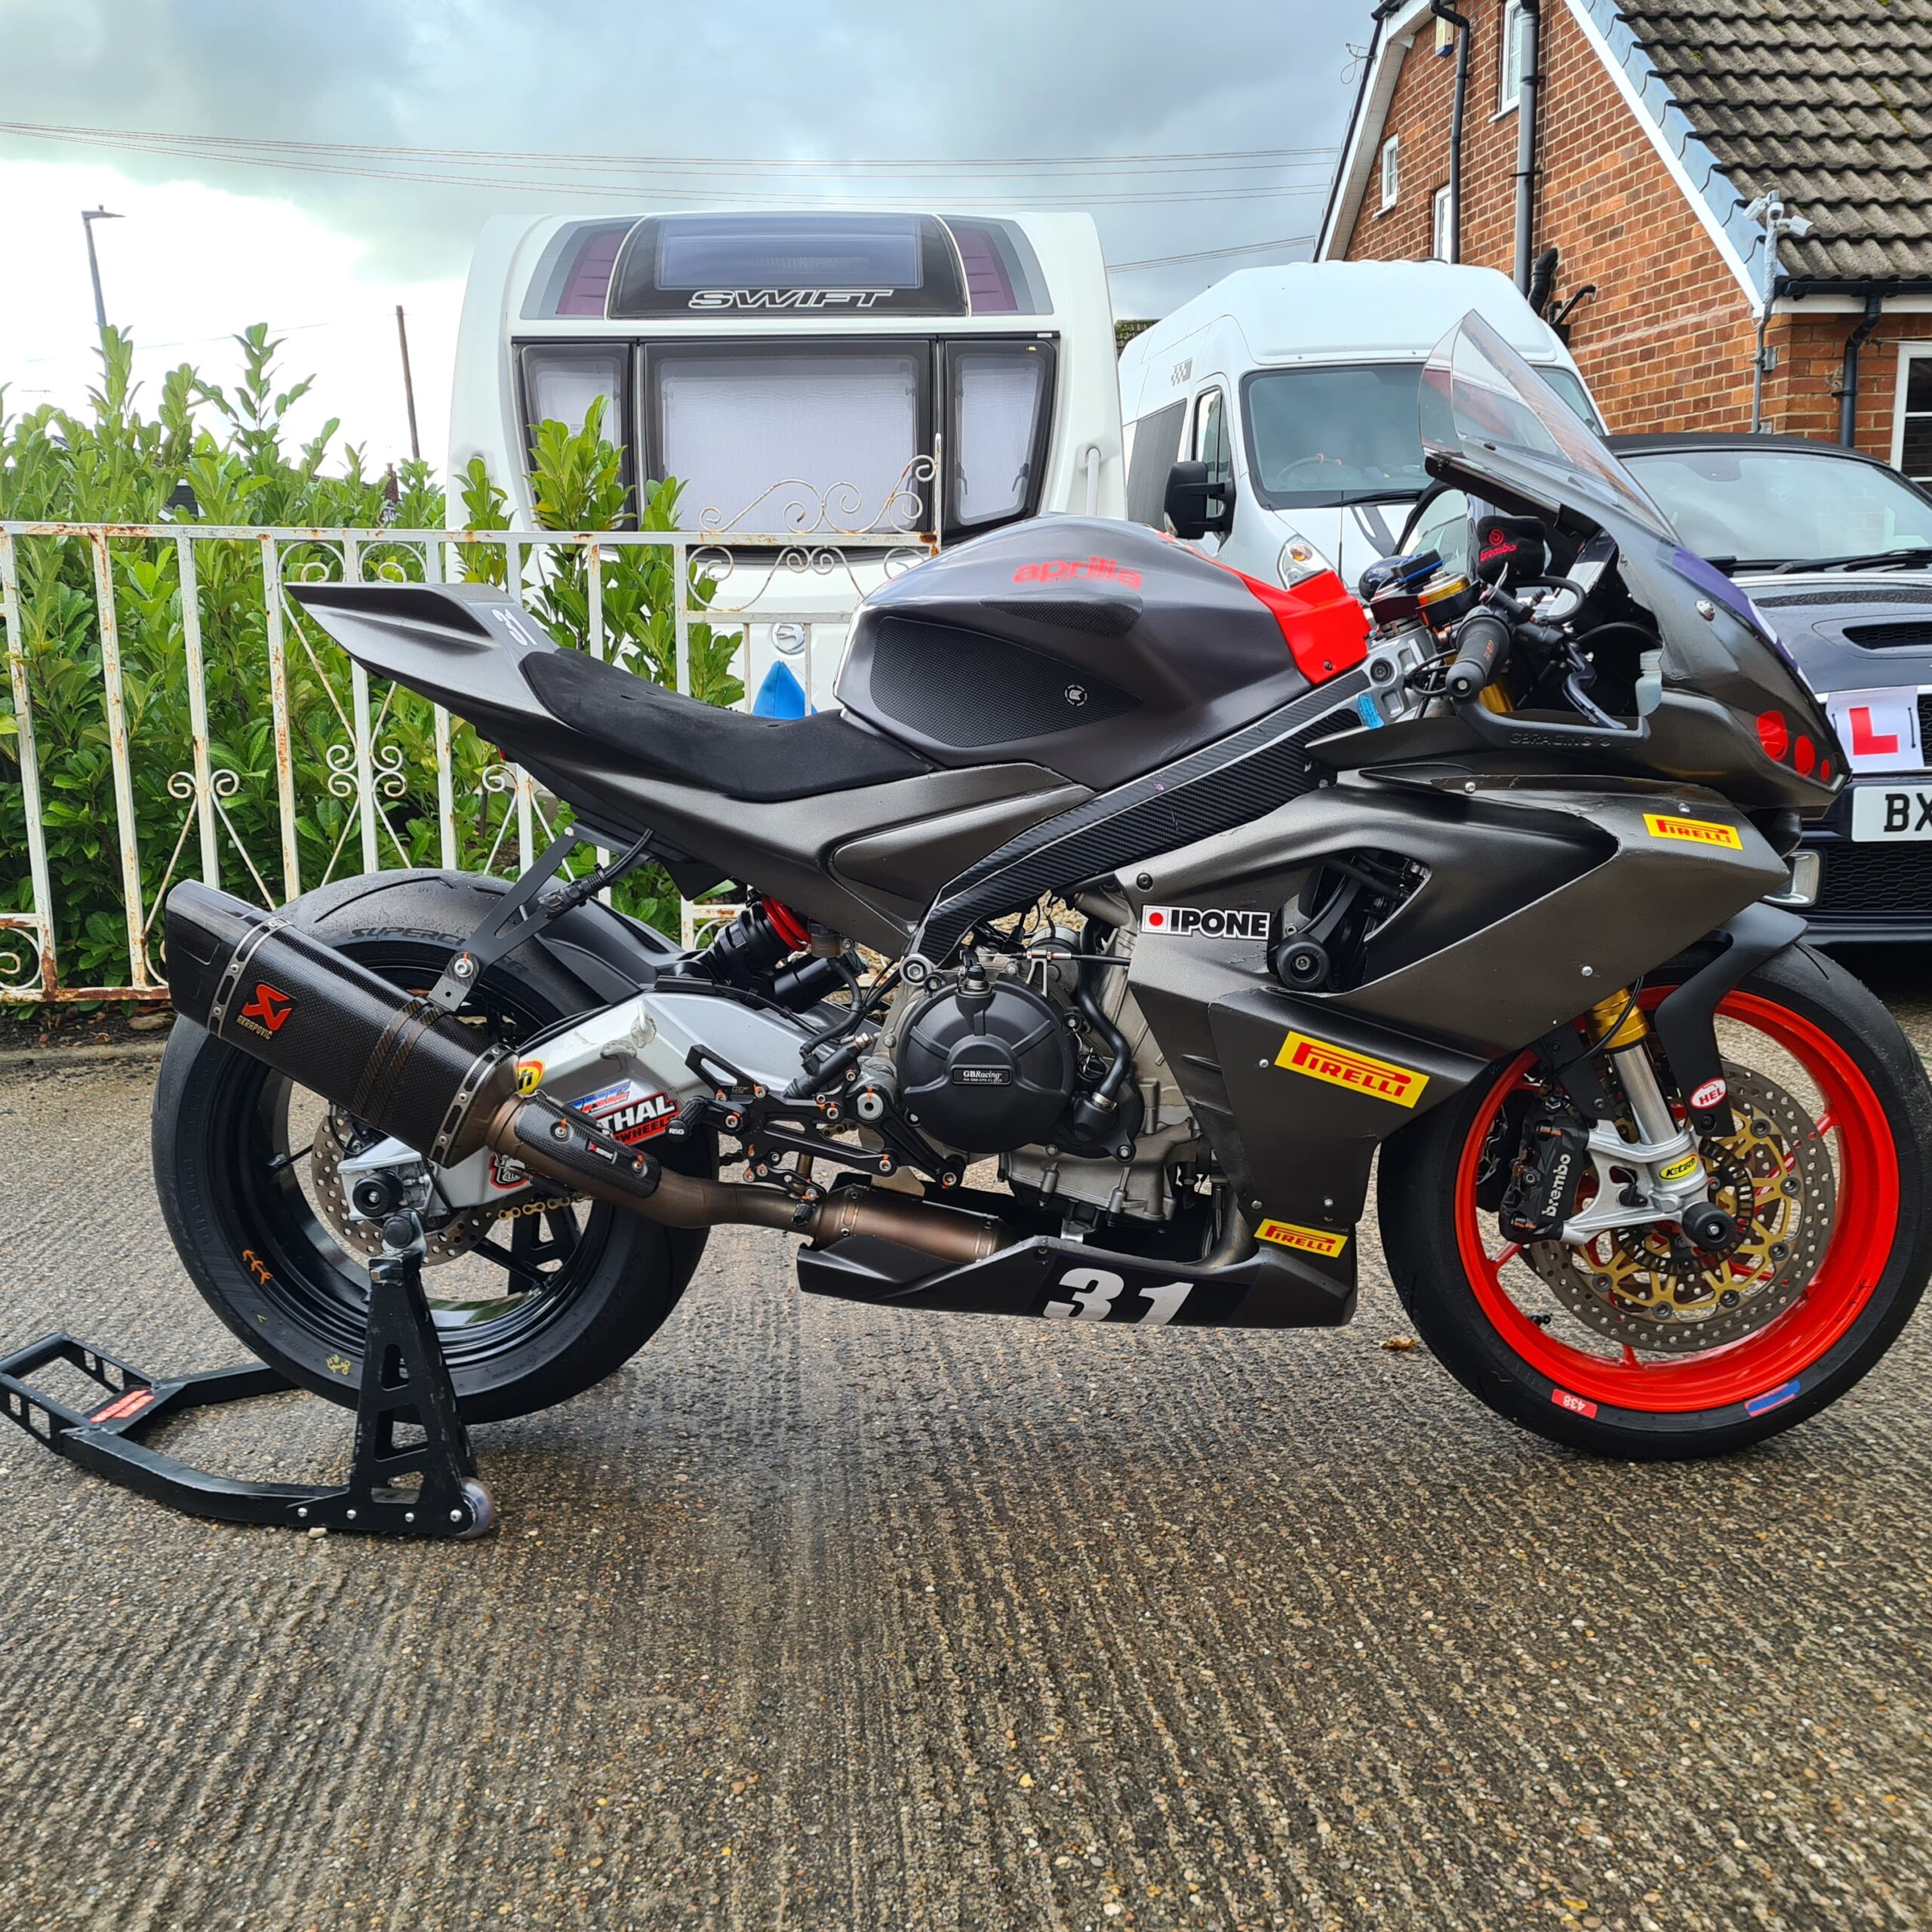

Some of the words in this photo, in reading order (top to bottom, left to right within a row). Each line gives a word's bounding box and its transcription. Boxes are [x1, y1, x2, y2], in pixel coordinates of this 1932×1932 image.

[688, 289, 894, 309] SWIFT
[1014, 556, 1143, 592] aprilia
[491, 608, 538, 646] 31
[1849, 706, 1900, 755] L
[1656, 819, 1731, 844] PIRELLI
[1170, 909, 1269, 938] IPONE
[1291, 1041, 1412, 1097] PIRELLI
[1699, 1088, 1724, 1105] HEL
[1541, 1154, 1571, 1217] brembo
[1264, 1224, 1336, 1253] PIRELLI
[1042, 1267, 1195, 1325] 31
[1563, 1395, 1586, 1411] 438
